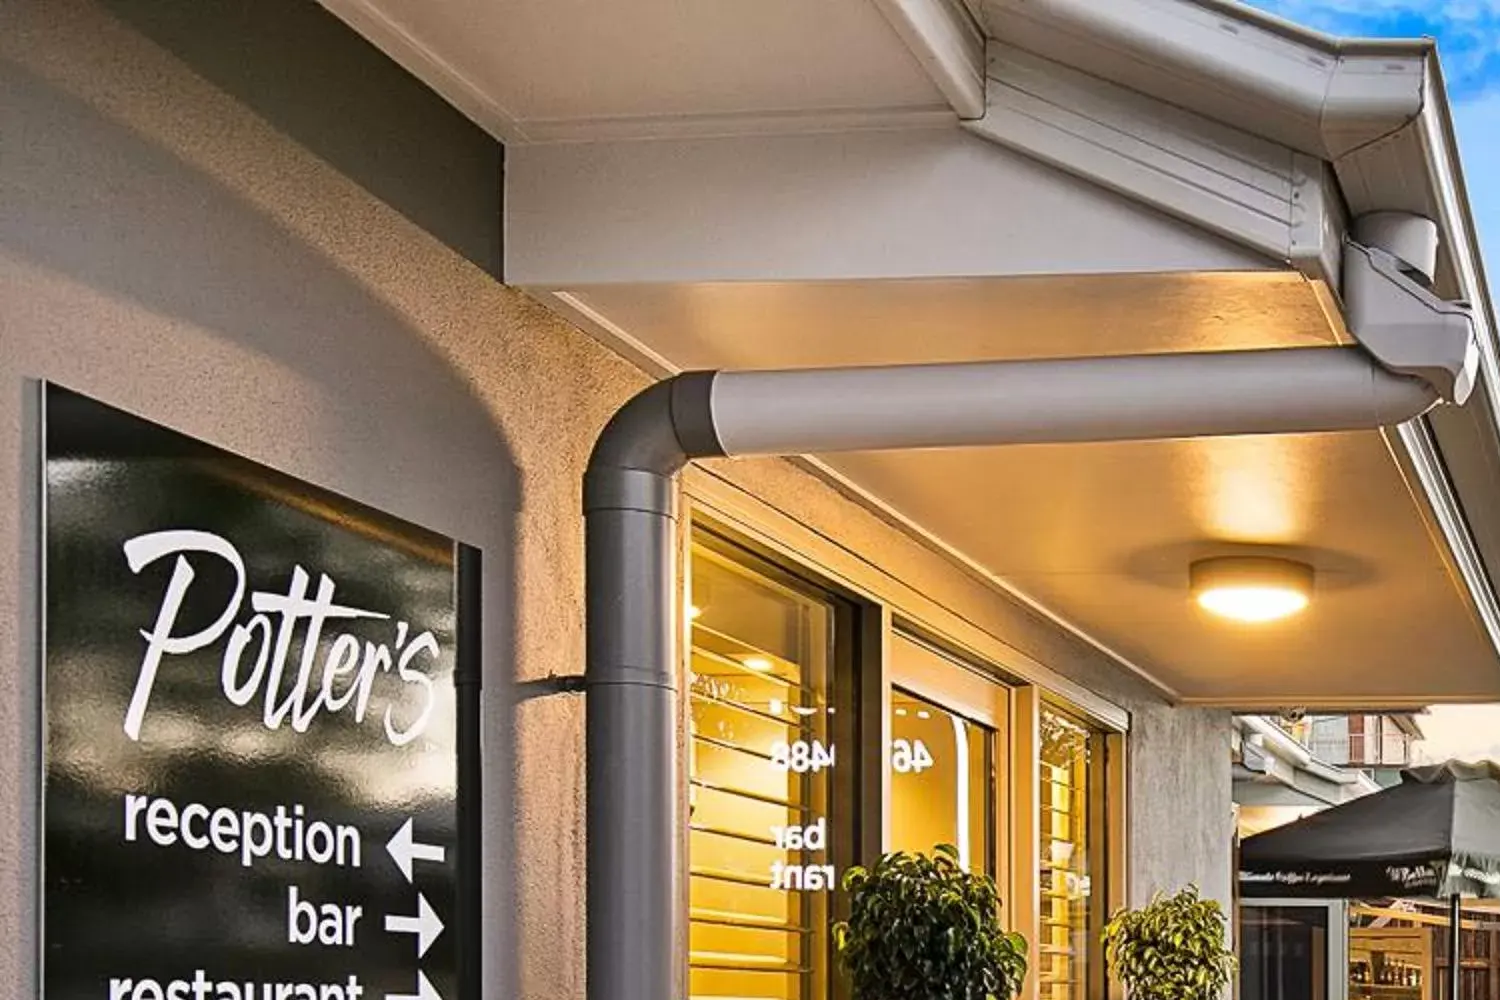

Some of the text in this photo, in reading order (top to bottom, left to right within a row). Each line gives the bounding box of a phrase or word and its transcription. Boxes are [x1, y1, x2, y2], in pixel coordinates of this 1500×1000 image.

[123, 529, 440, 747] Potter's
[124, 791, 362, 867] reception
[288, 886, 363, 946] bar
